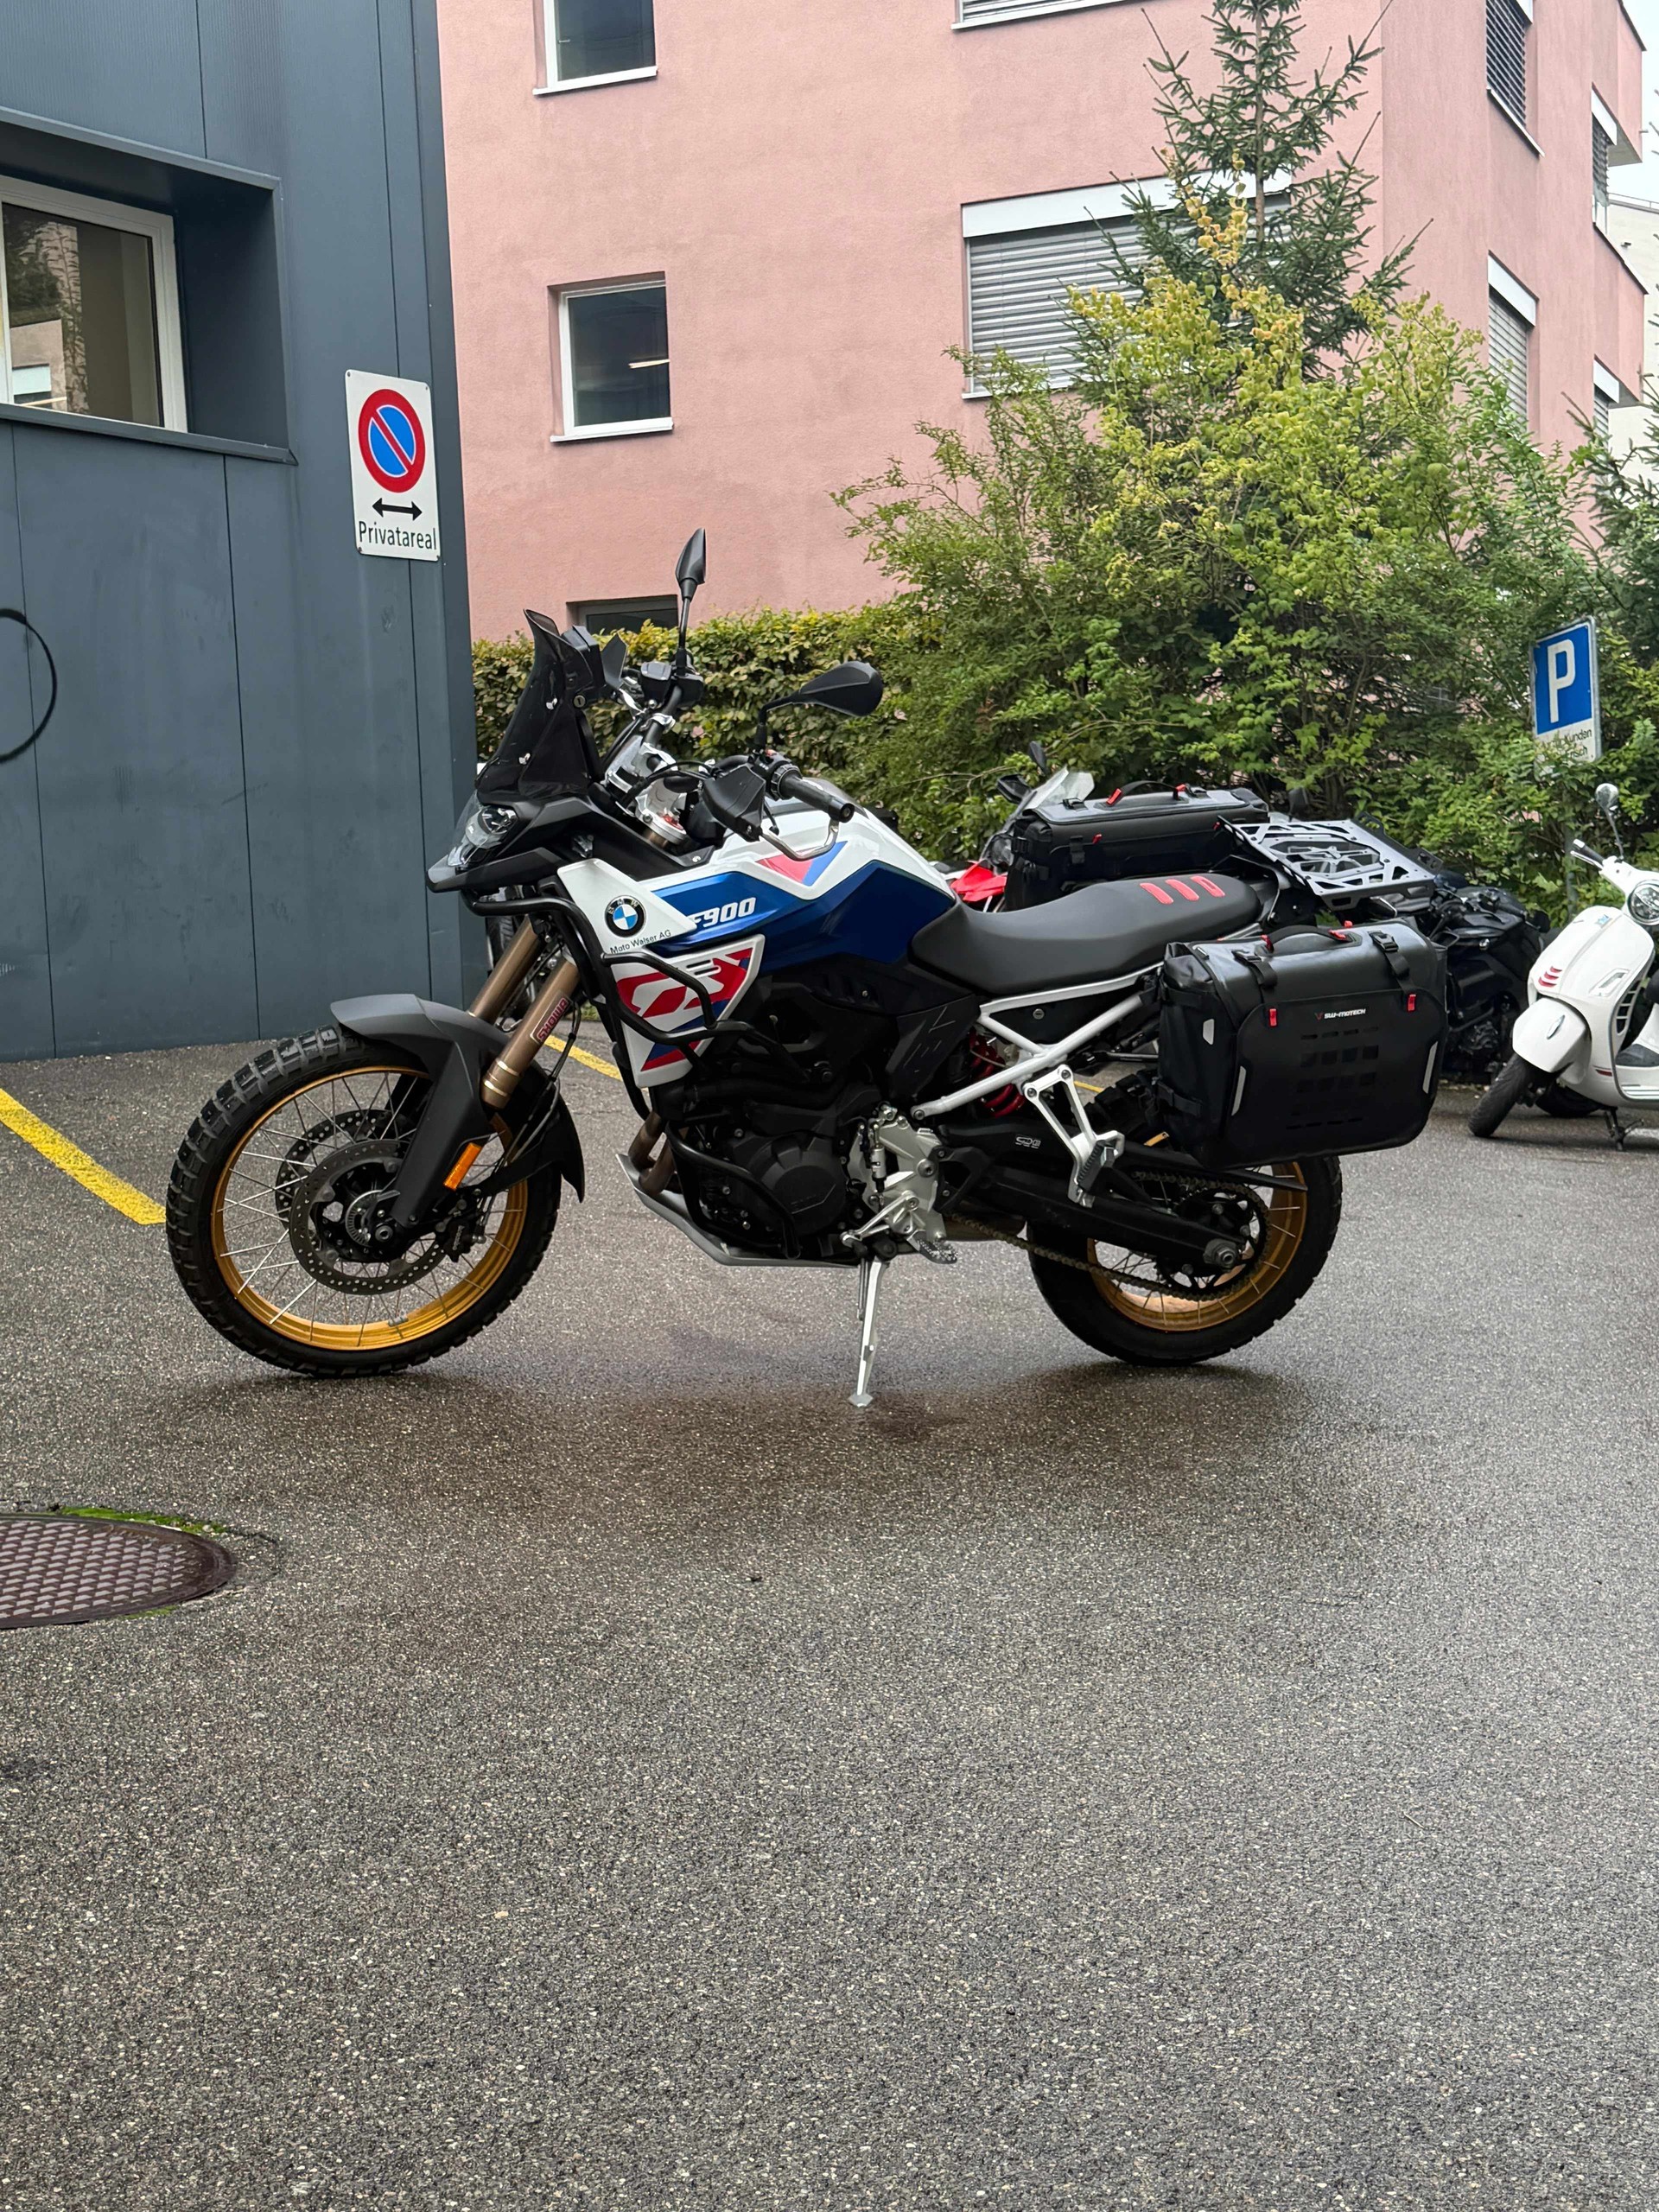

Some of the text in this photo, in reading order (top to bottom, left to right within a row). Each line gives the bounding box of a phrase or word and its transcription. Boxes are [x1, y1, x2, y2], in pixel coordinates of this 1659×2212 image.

[359, 521, 436, 550] Privatareal
[1548, 639, 1575, 723] P
[609, 929, 671, 955] Moto Walser AG
[537, 997, 569, 1040] SHOWA
[1324, 1009, 1366, 1019] SW-MOTECH
